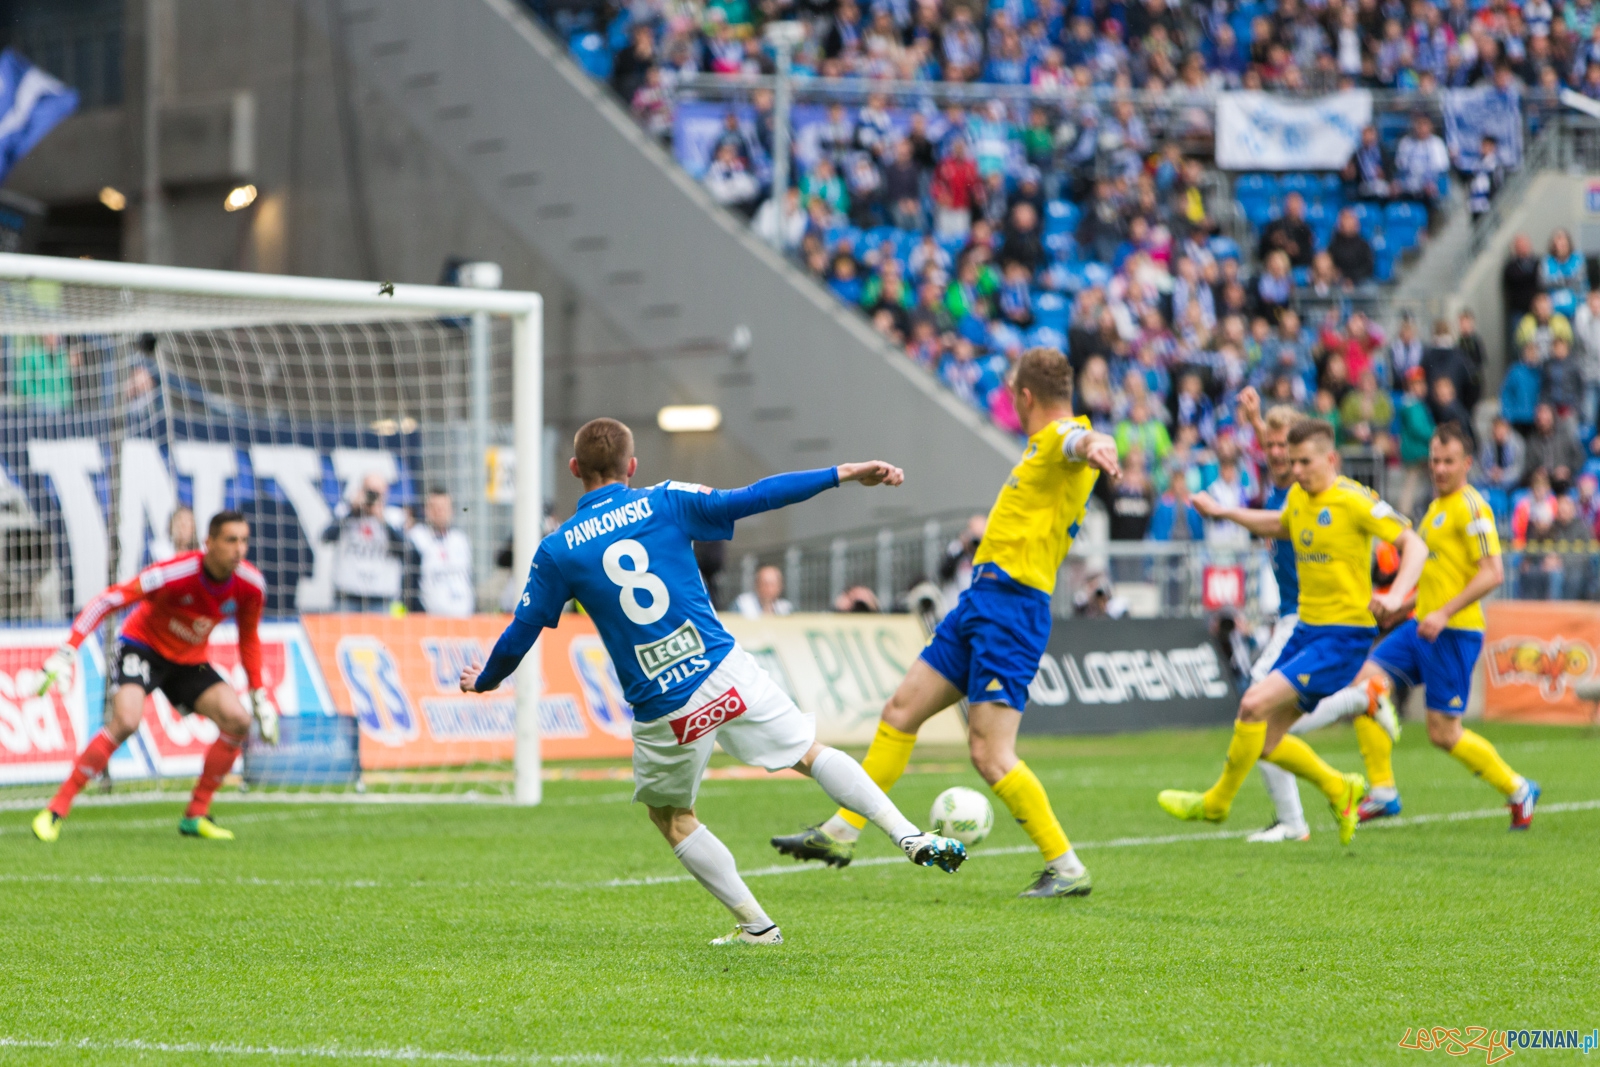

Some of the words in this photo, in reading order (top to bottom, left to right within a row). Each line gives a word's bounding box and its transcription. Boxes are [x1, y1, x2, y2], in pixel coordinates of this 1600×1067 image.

[564, 497, 654, 550] PAWŁOWSKI
[602, 538, 670, 625] 8
[643, 630, 696, 669] LECH
[657, 655, 711, 694] PILS
[1062, 642, 1228, 704] LORENTE
